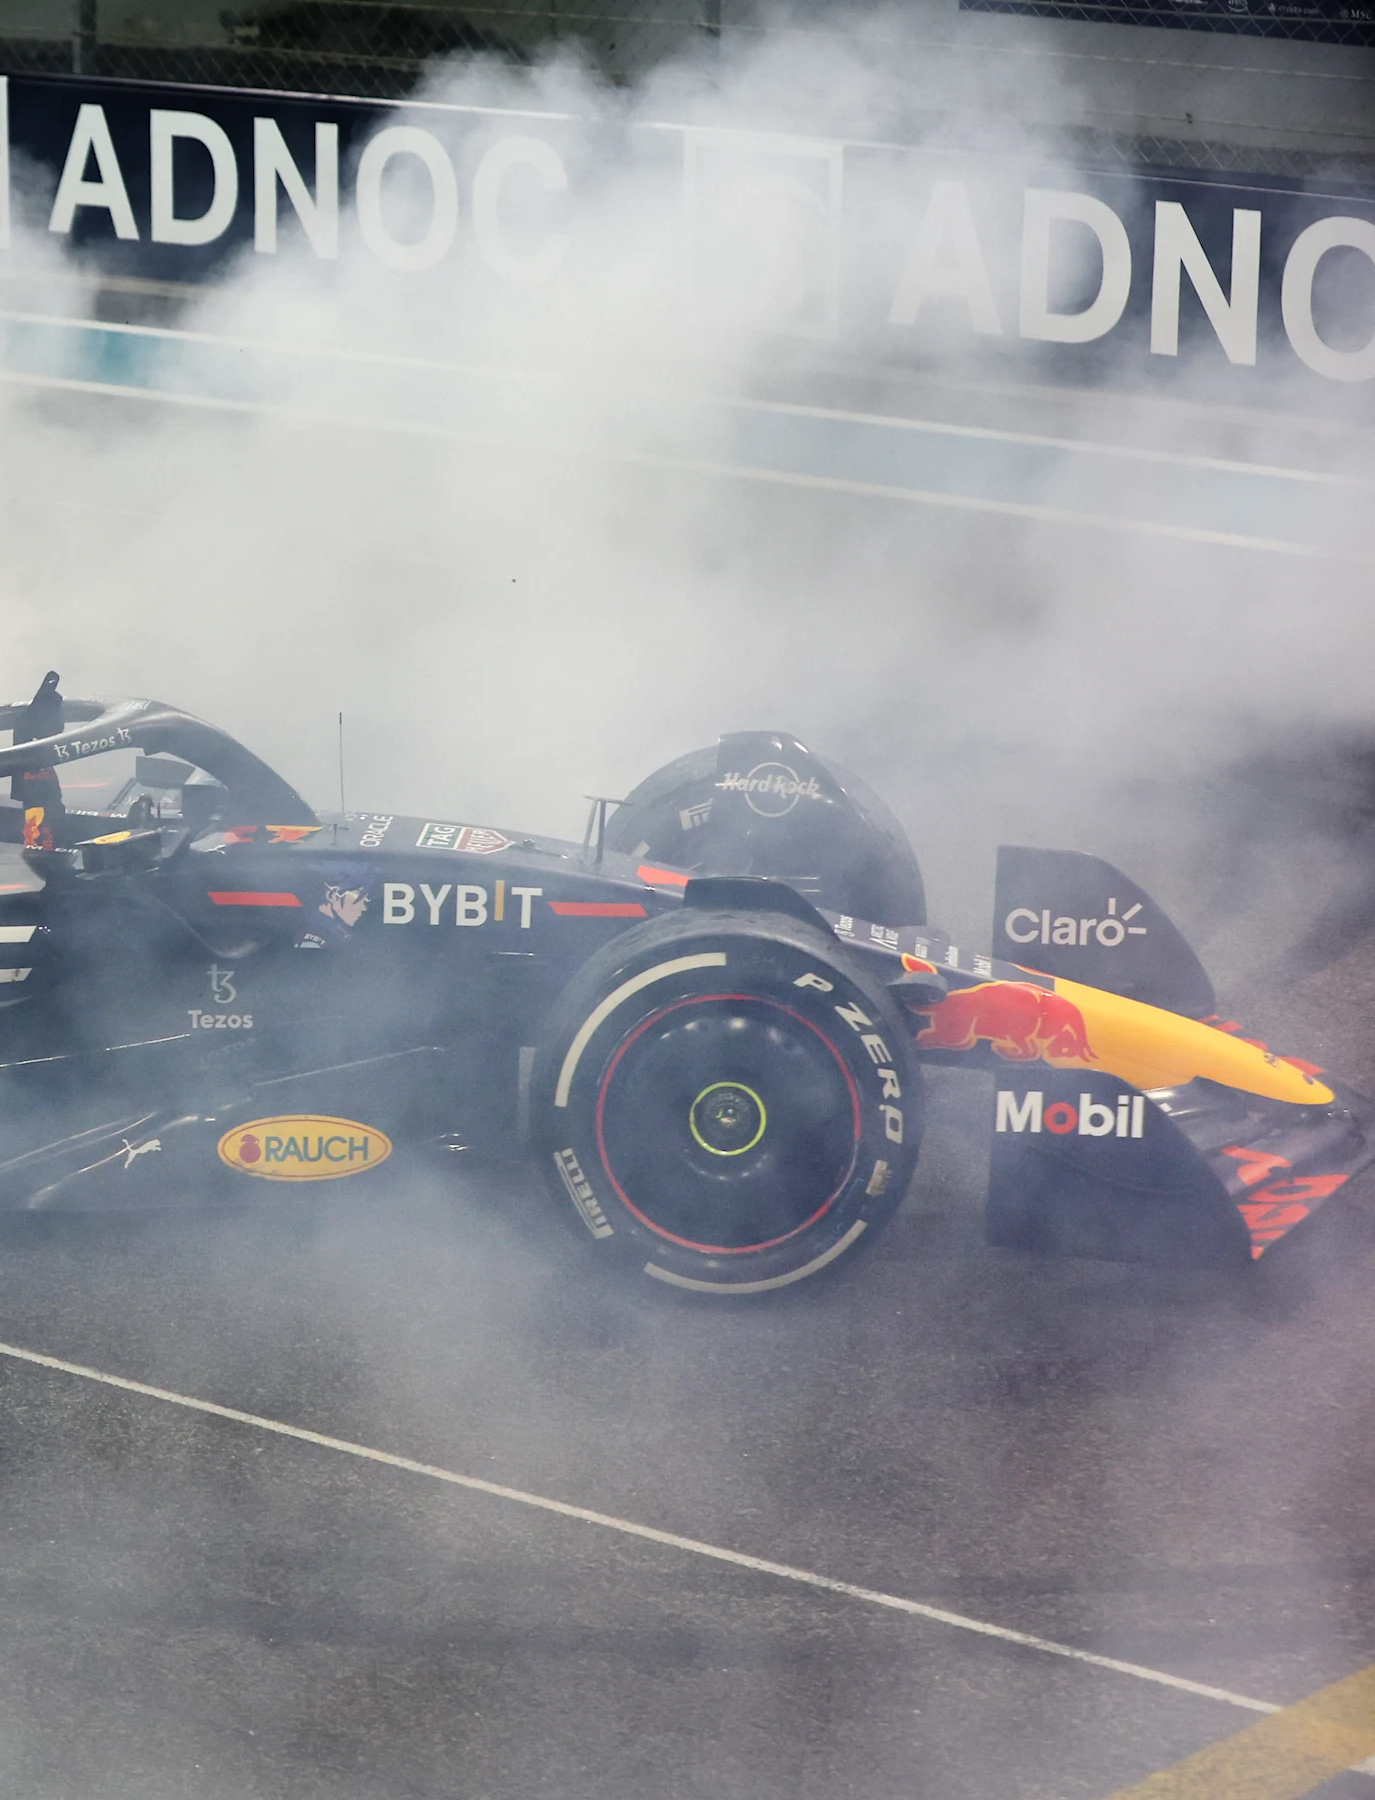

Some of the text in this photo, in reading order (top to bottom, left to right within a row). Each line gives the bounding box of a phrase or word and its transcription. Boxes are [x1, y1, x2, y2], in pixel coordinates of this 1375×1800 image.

[48, 103, 571, 282] ADNOC
[887, 180, 1375, 382] ADNO
[71, 736, 116, 755] Tezos
[722, 772, 820, 800] Hard Rock
[359, 815, 394, 848] ORACLE
[427, 826, 456, 846] TAG
[383, 880, 543, 929] BYBIT
[1005, 907, 1126, 947] Claro
[187, 1009, 254, 1029] Tezos
[793, 973, 834, 992] P
[834, 1001, 903, 1144] ZERO
[995, 1090, 1145, 1139] Mobil
[263, 1135, 370, 1164] RAUCH
